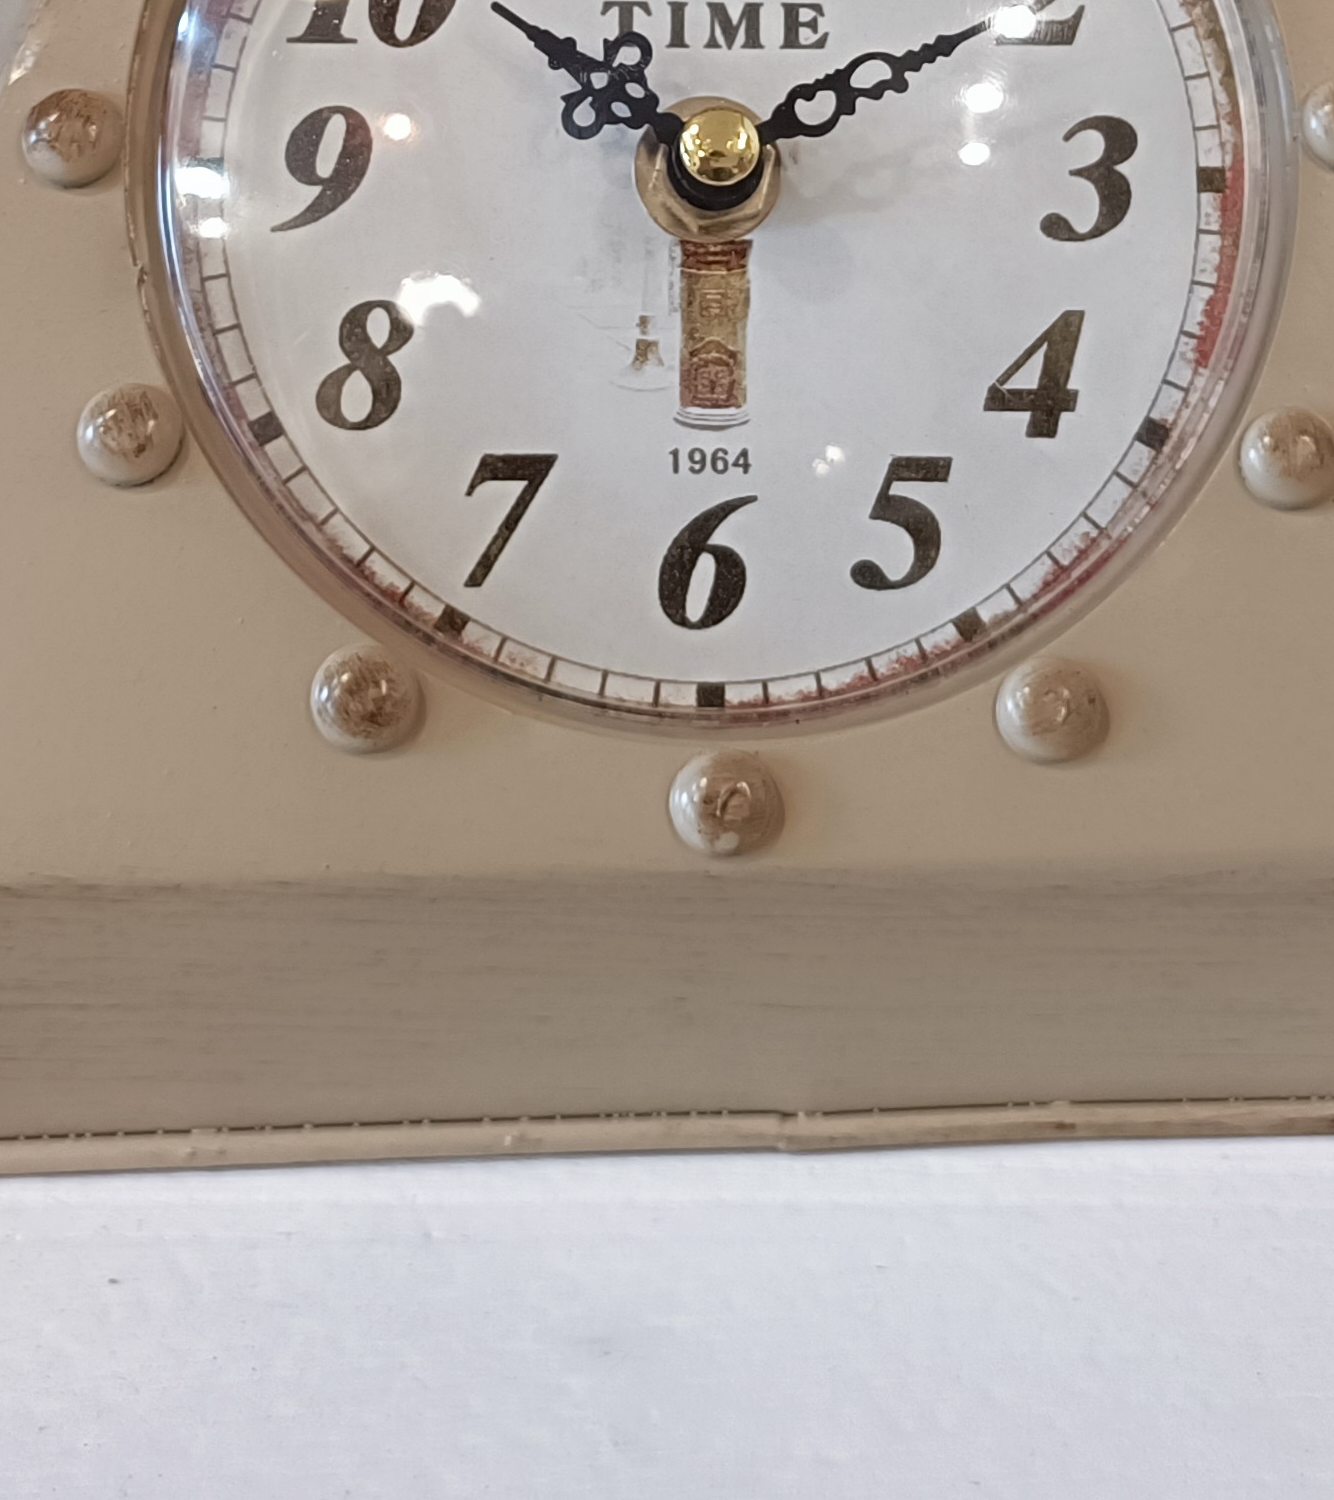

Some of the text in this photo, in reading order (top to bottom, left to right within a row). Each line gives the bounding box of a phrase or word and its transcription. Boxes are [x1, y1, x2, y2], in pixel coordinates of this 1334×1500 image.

[599, 0, 830, 51] TIME
[270, 105, 373, 233] 9
[1039, 115, 1139, 243] 3
[315, 299, 415, 432] 8
[983, 309, 1086, 439] 4
[463, 453, 559, 588] 7
[668, 447, 753, 476] 1964
[849, 456, 954, 592] 5
[657, 495, 758, 631] 6
